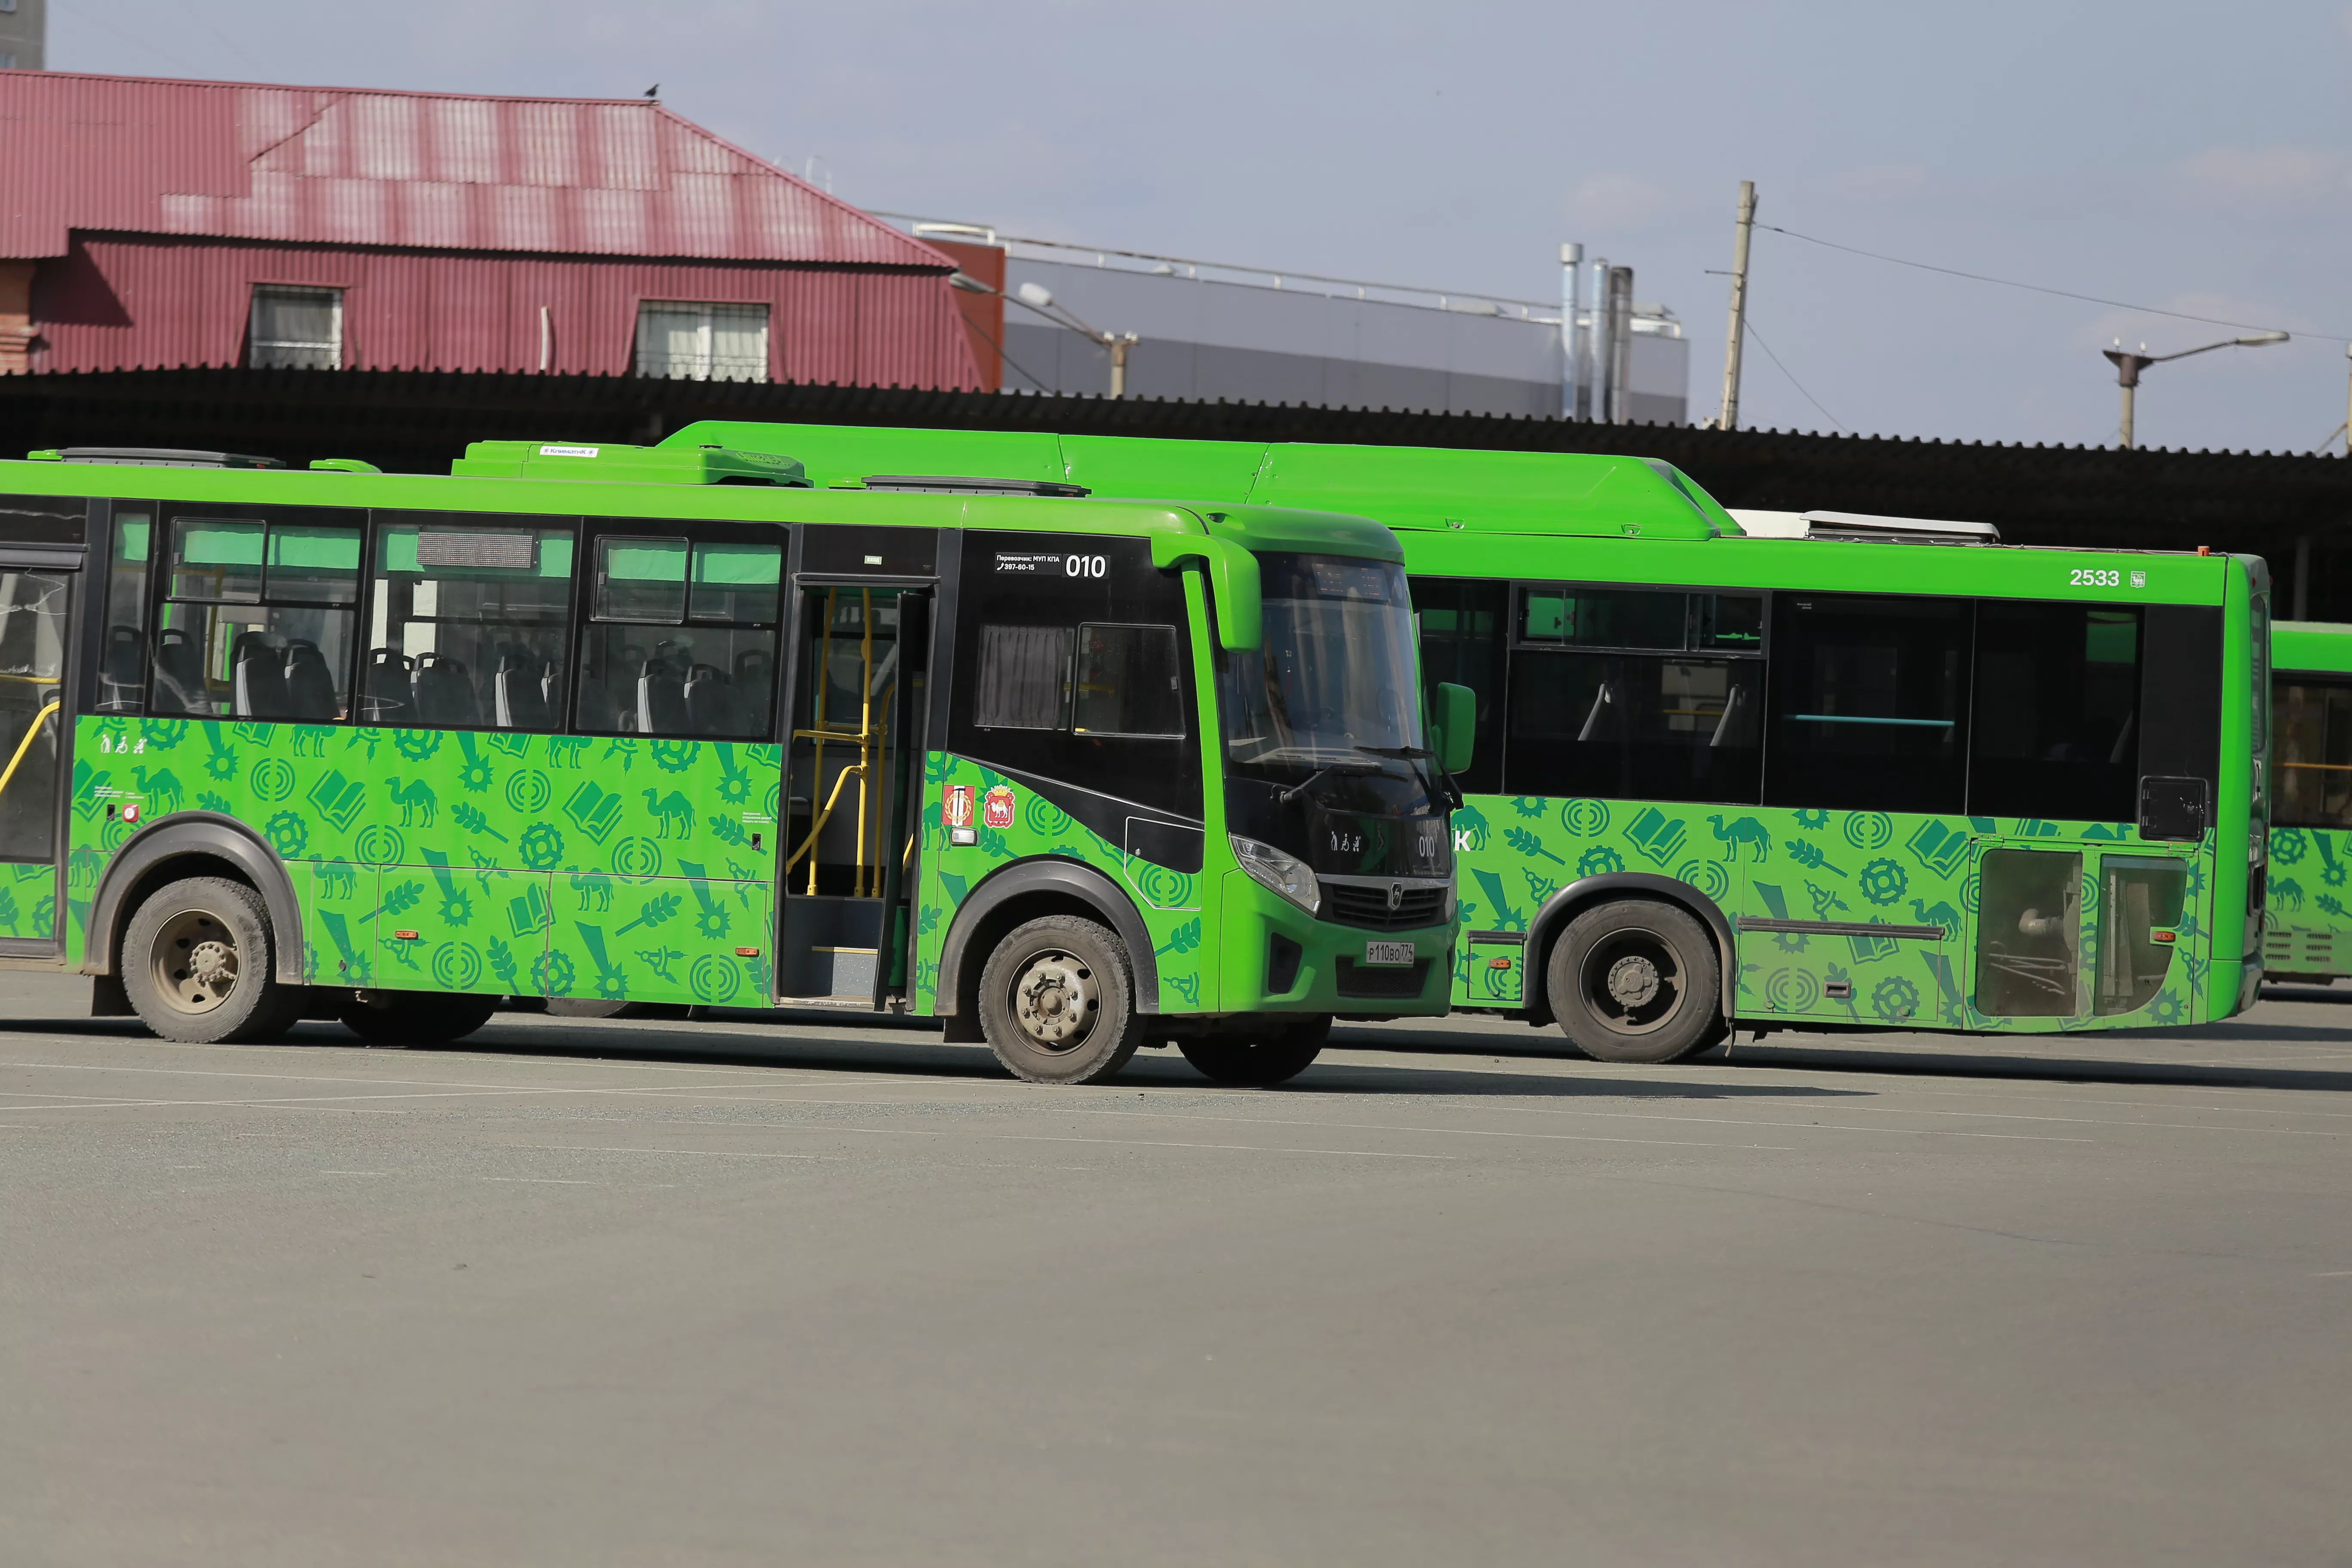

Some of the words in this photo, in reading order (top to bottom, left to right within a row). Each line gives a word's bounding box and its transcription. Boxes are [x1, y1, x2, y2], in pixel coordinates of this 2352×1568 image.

[1066, 555, 1106, 578] 010
[2070, 569, 2119, 586] 2533
[1419, 836, 1434, 857] 010
